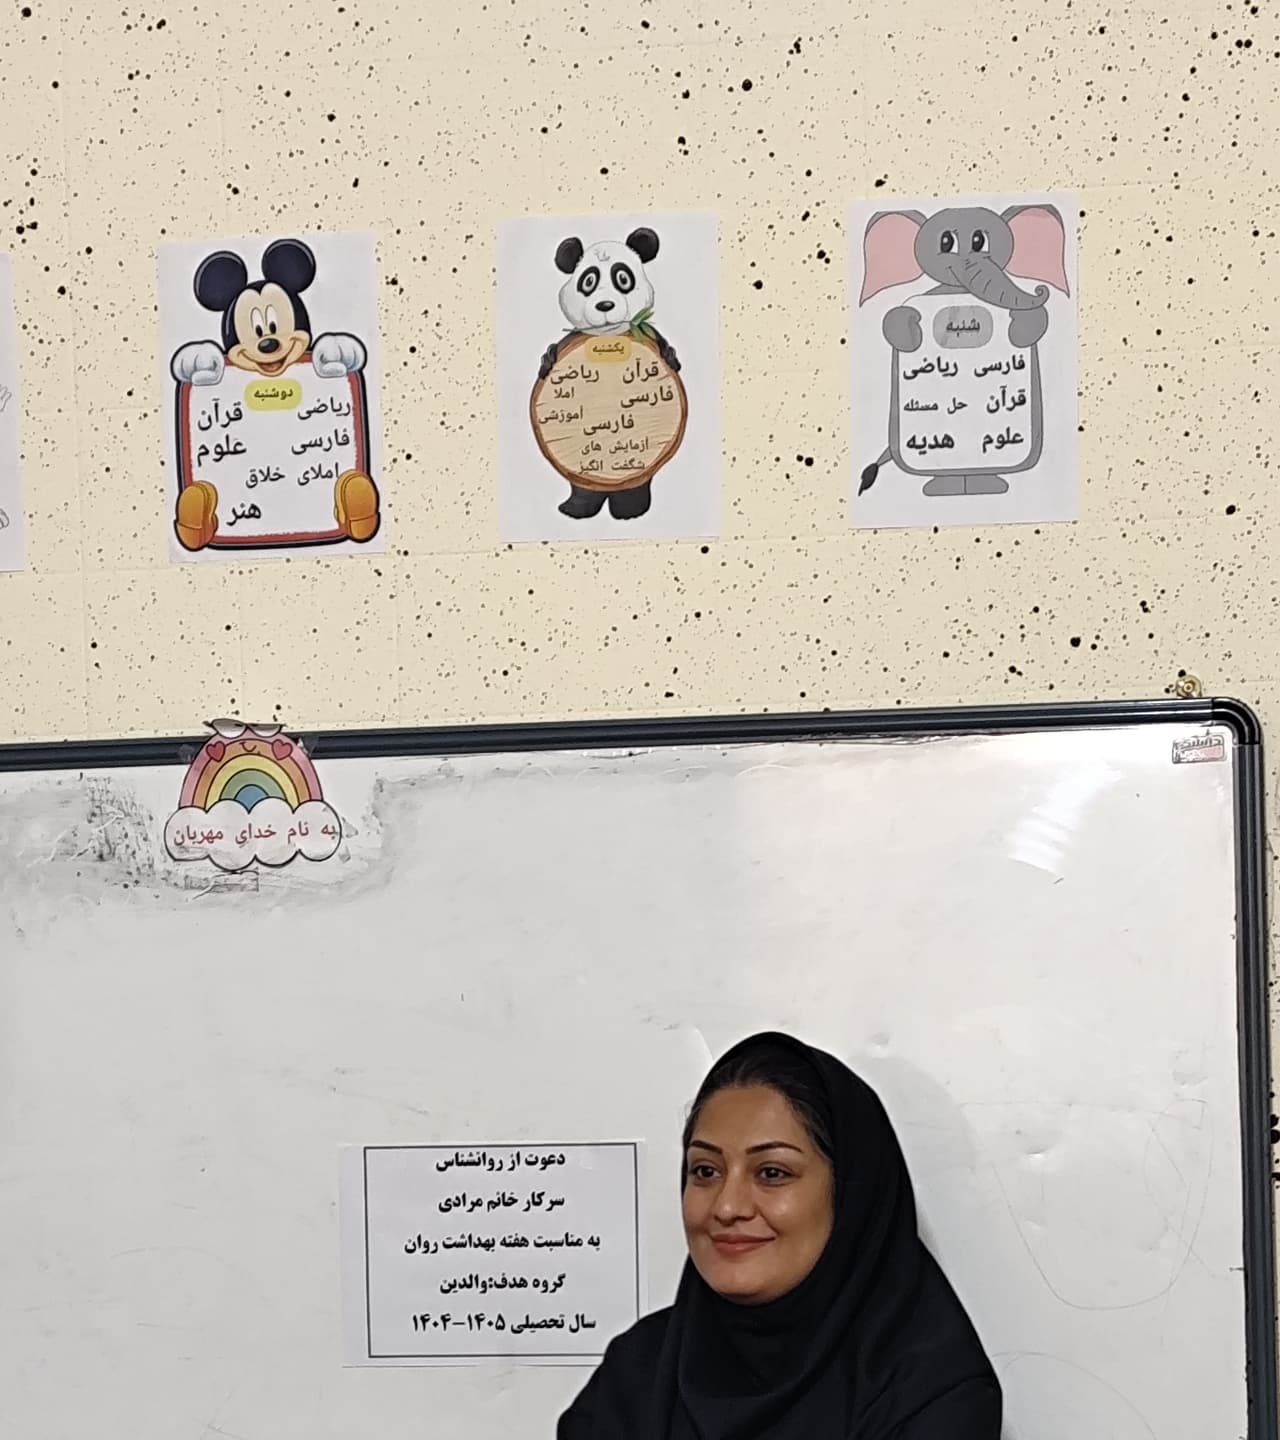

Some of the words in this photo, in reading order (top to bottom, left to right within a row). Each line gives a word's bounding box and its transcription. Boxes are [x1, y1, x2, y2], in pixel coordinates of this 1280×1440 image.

[592, 343, 624, 355] یکشنبه
[550, 365, 599, 385] ریاضی
[623, 359, 659, 384] قرآن
[903, 356, 958, 379] ریاضی
[974, 355, 1025, 377] فارسی
[254, 387, 293, 399] دوشنبه
[554, 387, 574, 399] املا
[620, 385, 673, 408] فارسی
[986, 387, 1027, 413] قرآن
[198, 397, 242, 431] قرآن
[297, 396, 351, 420] ریاضی
[903, 398, 938, 412] مسئله
[947, 397, 967, 414] حل
[582, 414, 634, 435] فارسی
[291, 429, 350, 454] فارسی
[581, 440, 601, 455] های
[906, 432, 954, 454] هدیه
[982, 426, 1024, 453] علوم
[196, 435, 246, 466] علوم
[297, 462, 339, 486] املای
[577, 460, 603, 474] انگیز
[611, 459, 645, 471] شگفت
[245, 465, 285, 488] خلاق
[226, 501, 262, 525] هنر
[174, 825, 223, 845] مهربان
[287, 822, 309, 844] نام
[321, 823, 338, 840] به
[436, 1151, 502, 1172] روانشناس
[508, 1151, 520, 1169] از
[524, 1153, 566, 1169] دعوت
[438, 1192, 482, 1212] مرادی
[487, 1191, 518, 1212] خانم
[404, 1234, 438, 1254] روان
[442, 1233, 496, 1252] بهداشت
[500, 1234, 529, 1248] هفته
[534, 1232, 583, 1252] مناسبت
[587, 1232, 601, 1252] به
[532, 1273, 566, 1292] گروه
[511, 1314, 564, 1334] تحصیلی
[569, 1314, 596, 1333] سال
